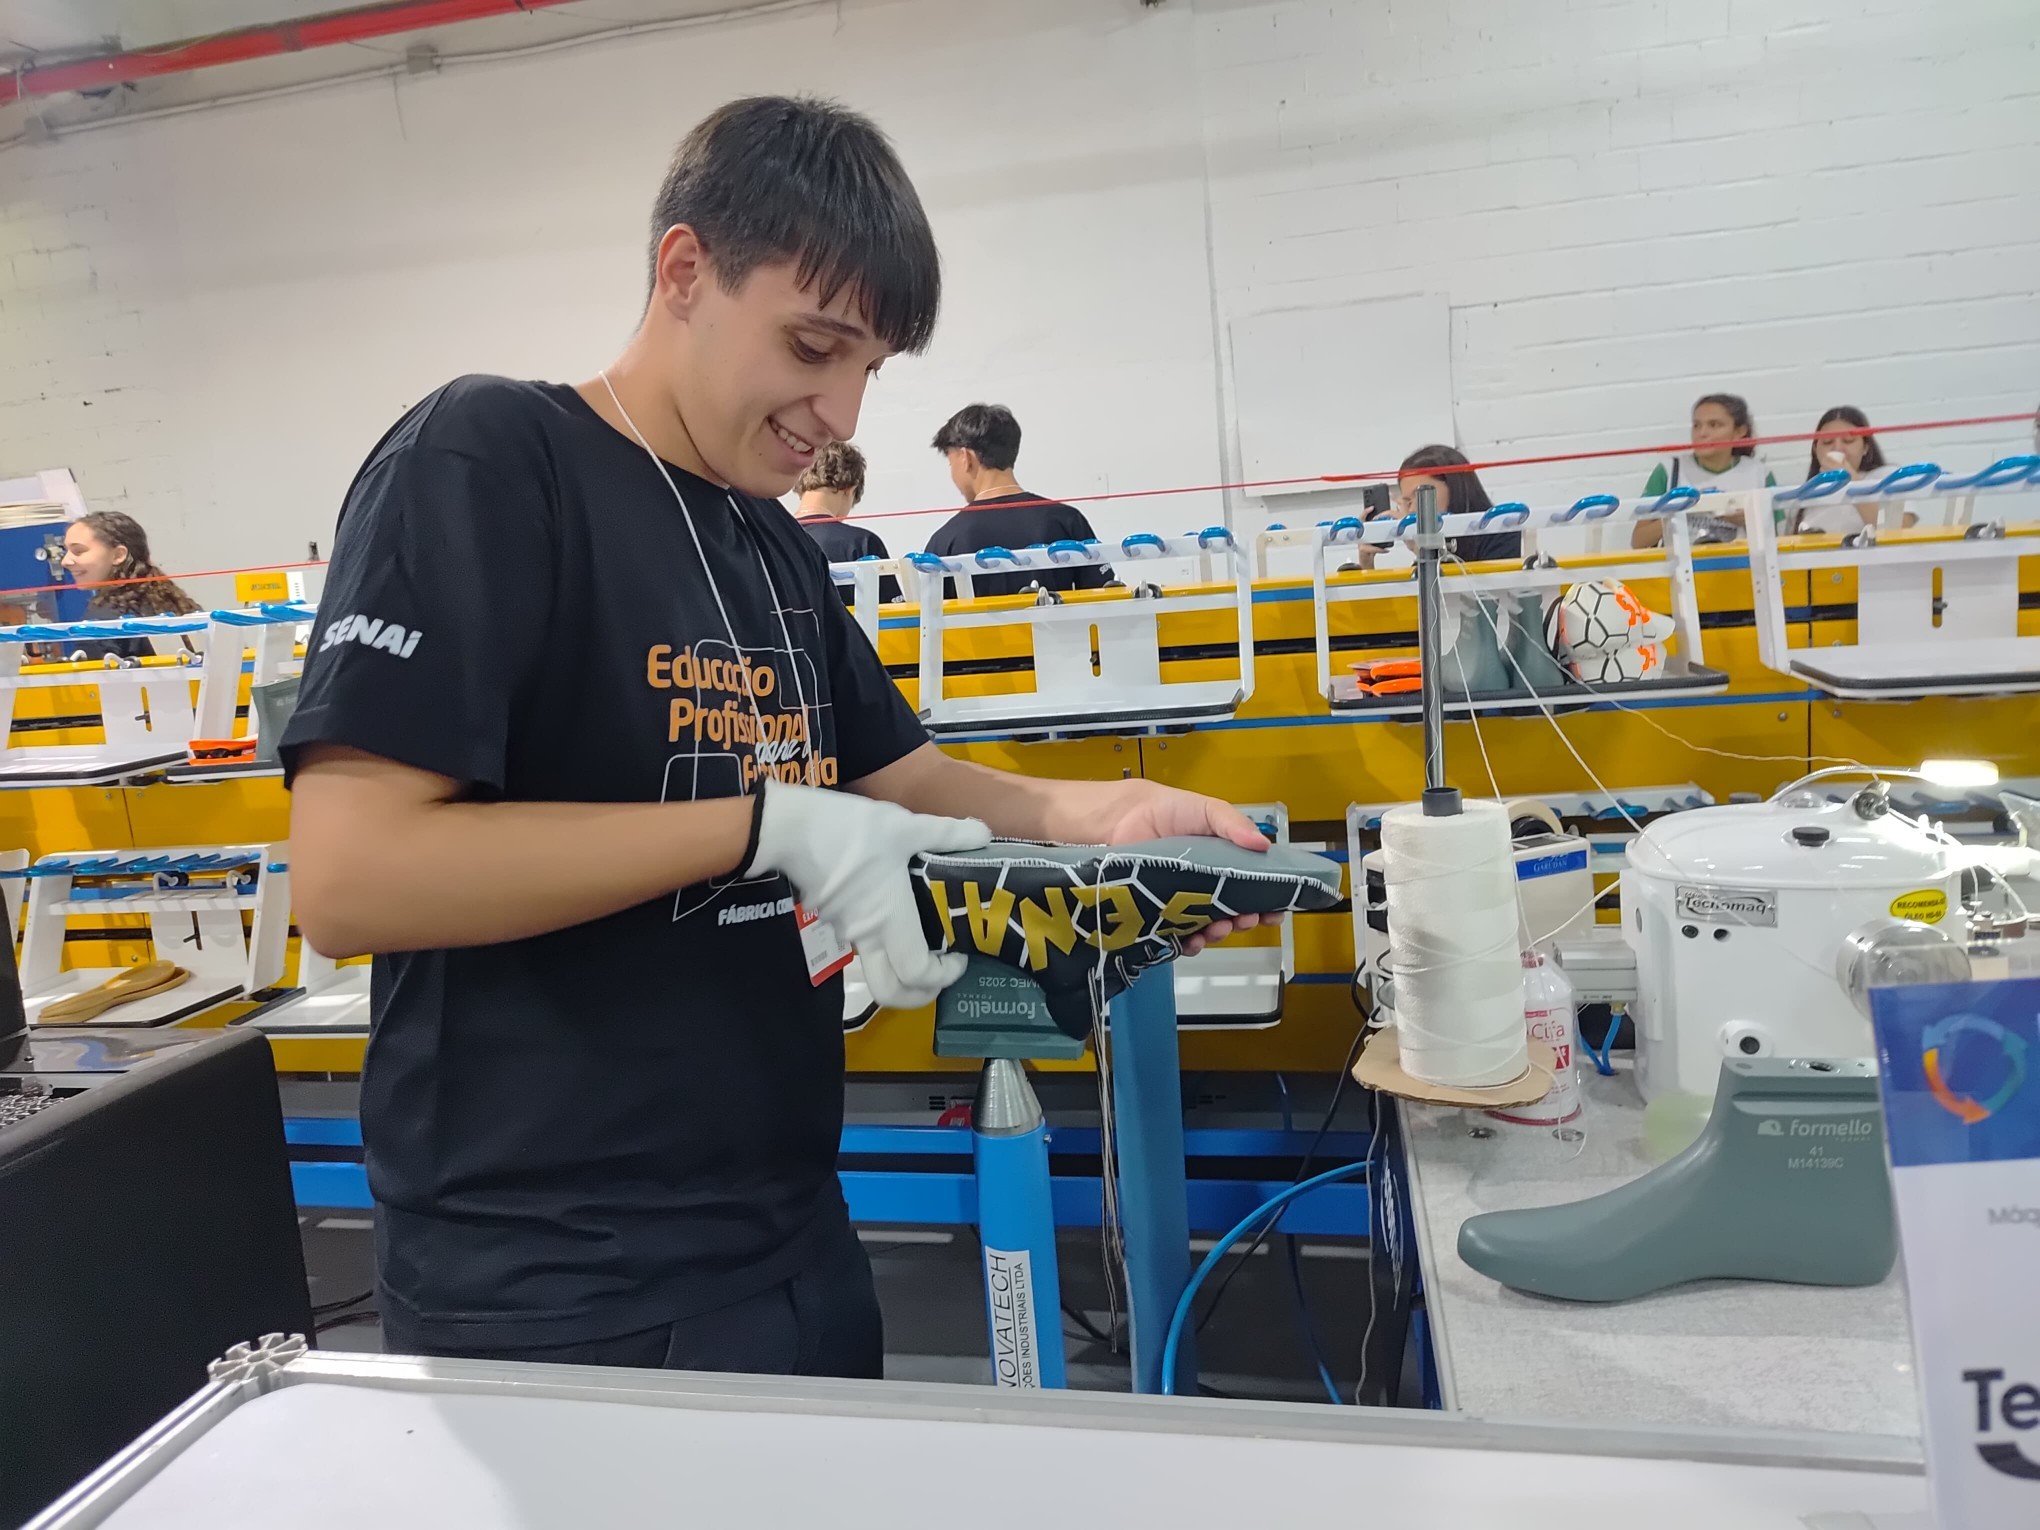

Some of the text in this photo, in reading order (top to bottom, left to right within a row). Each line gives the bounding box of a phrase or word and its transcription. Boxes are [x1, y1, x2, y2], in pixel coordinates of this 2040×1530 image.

[319, 614, 423, 659] SENAI
[718, 901, 775, 926] FÁBRICA
[1685, 896, 1766, 915] Tecnomaq
[979, 976, 1040, 988] MEC 2025
[958, 1000, 1036, 1019] formello
[1790, 1119, 1873, 1136] formello
[1013, 1262, 1025, 1290] LTDA
[1014, 1293, 1030, 1358] INDUSTRIAIS
